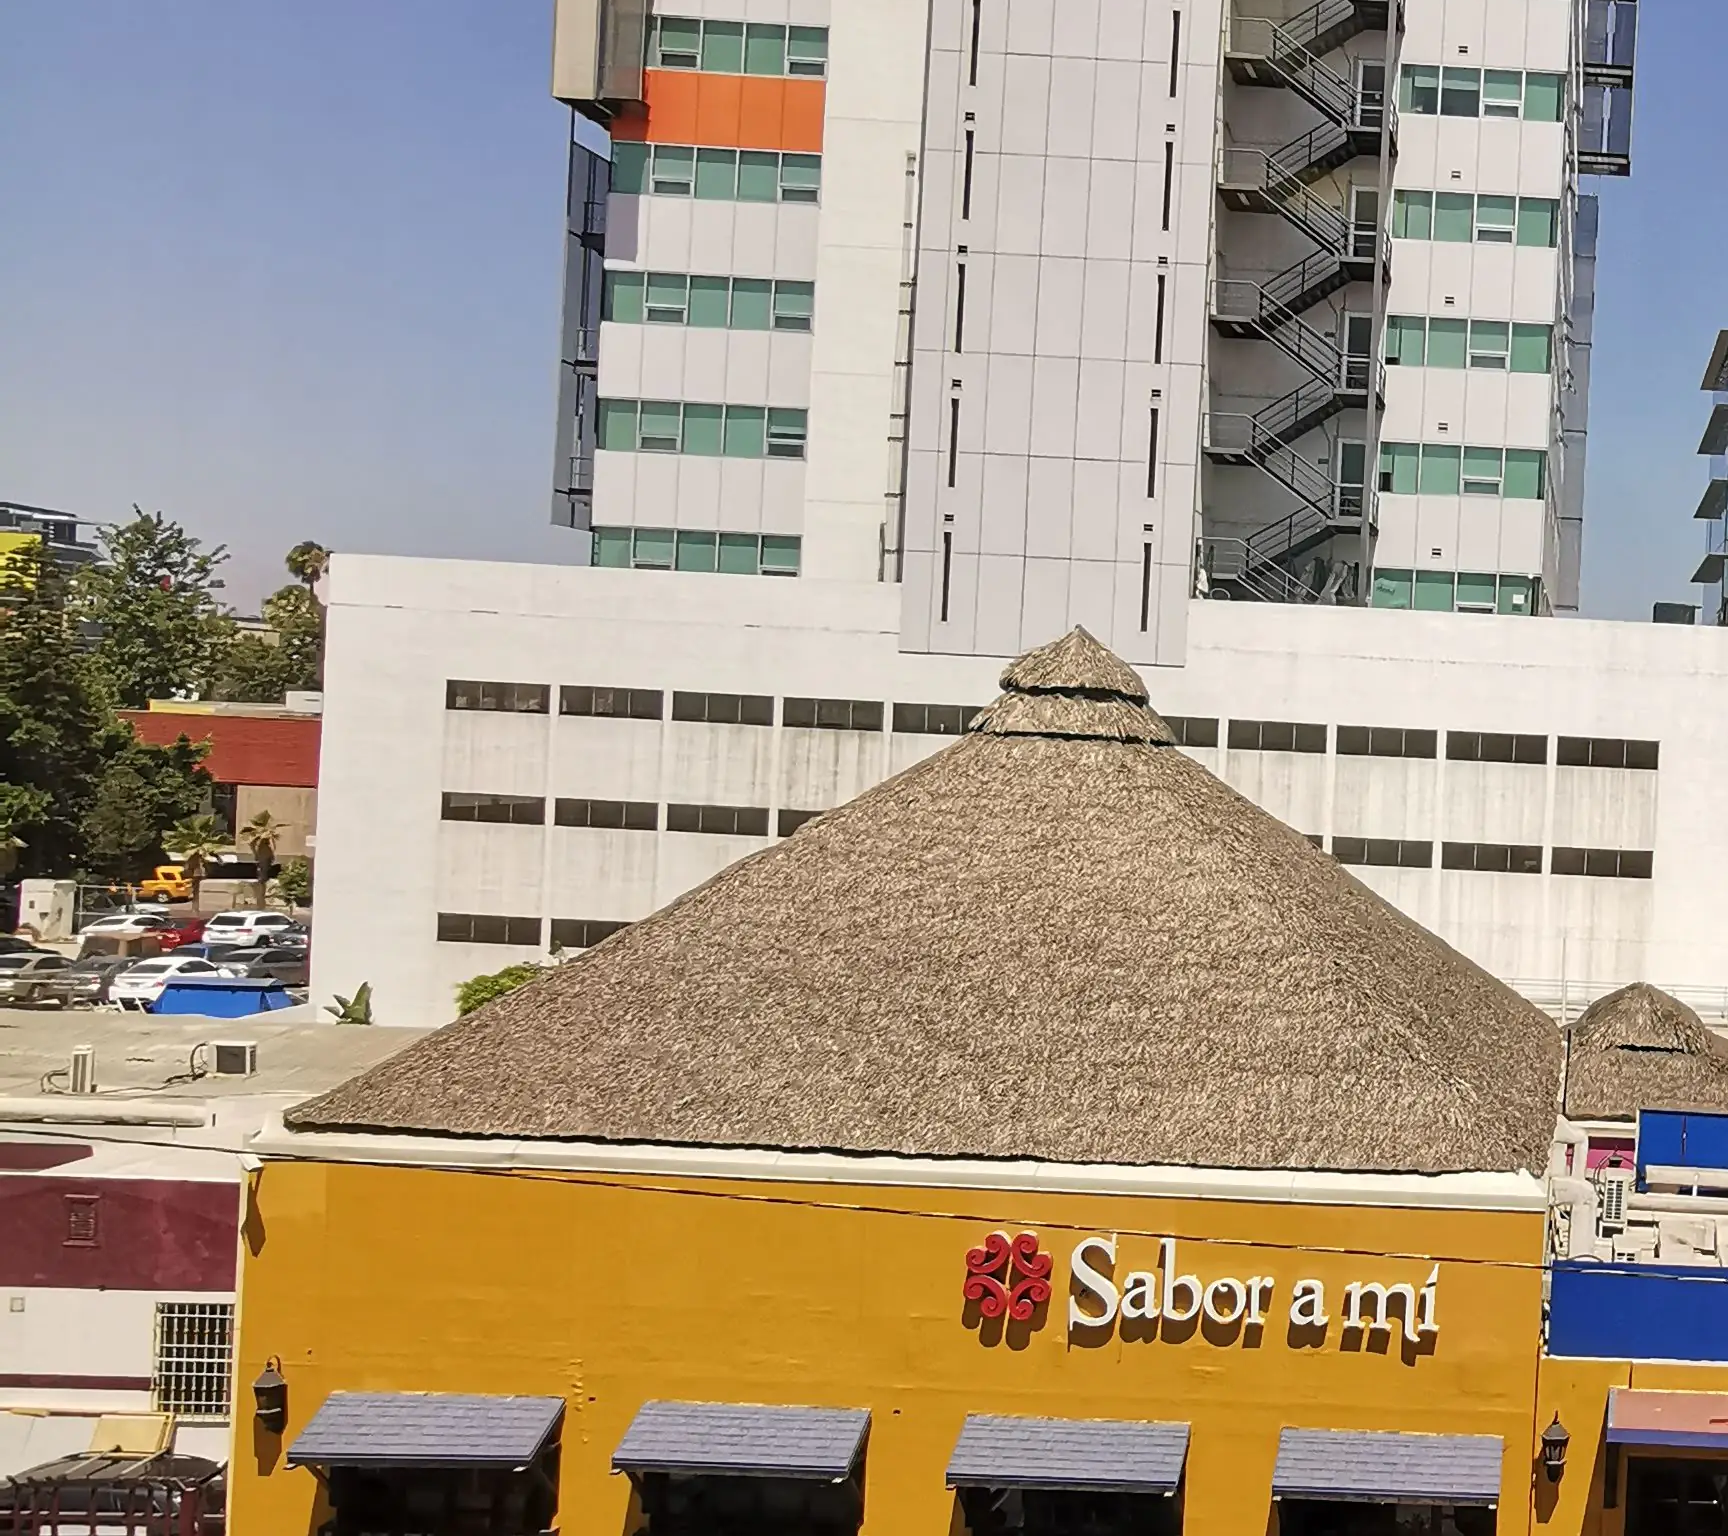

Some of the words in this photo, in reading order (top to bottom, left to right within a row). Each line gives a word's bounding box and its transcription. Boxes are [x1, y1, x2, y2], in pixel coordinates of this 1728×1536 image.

[1067, 1233, 1275, 1331] Sabor
[1289, 1278, 1329, 1327] a
[1342, 1262, 1441, 1343] mí
